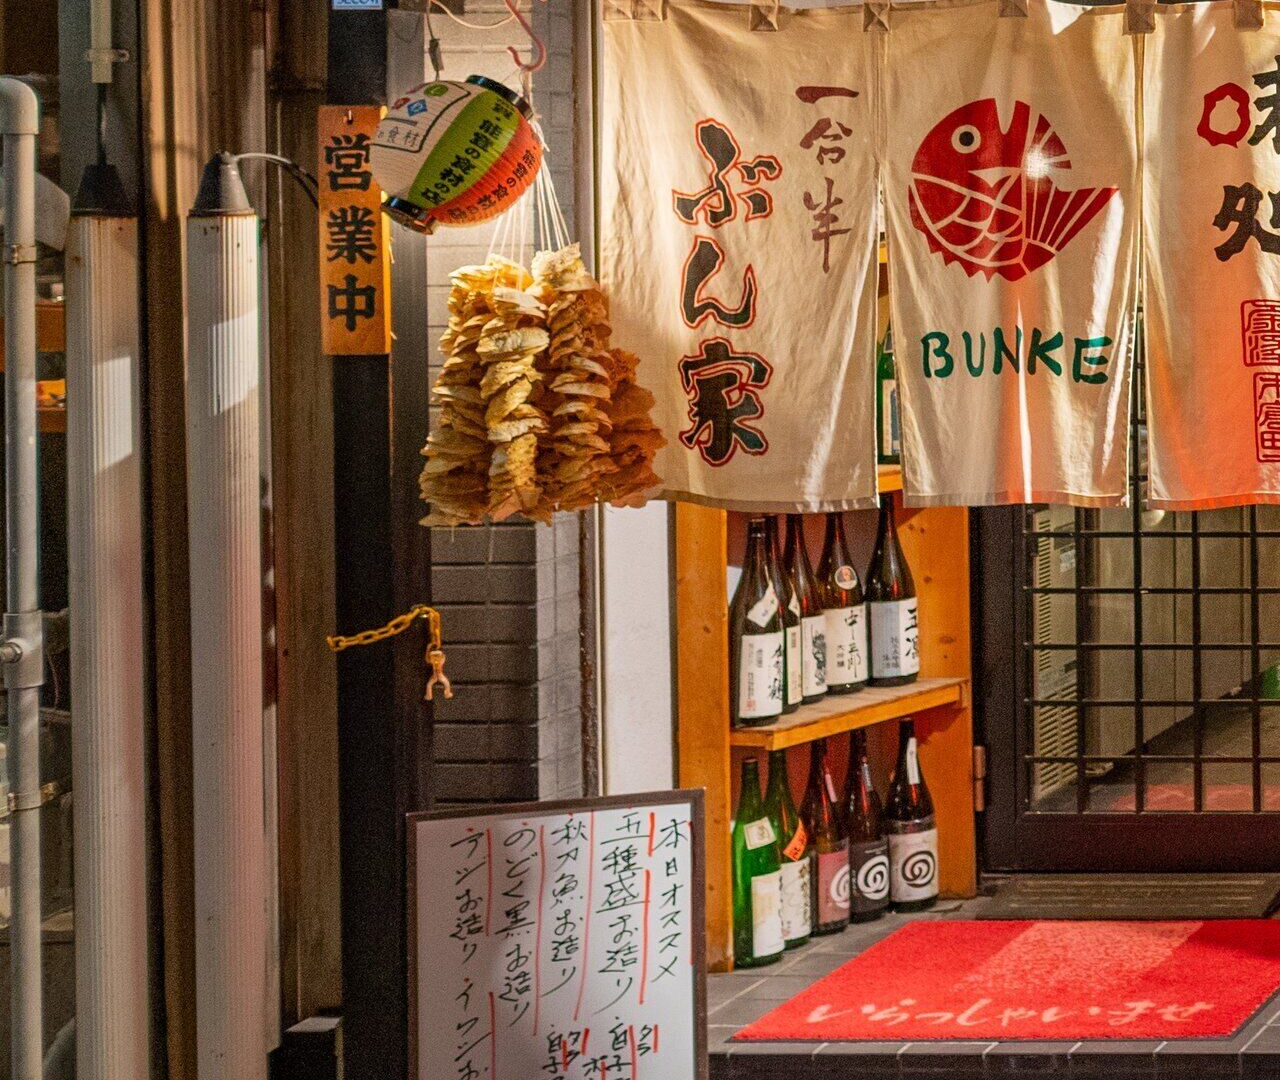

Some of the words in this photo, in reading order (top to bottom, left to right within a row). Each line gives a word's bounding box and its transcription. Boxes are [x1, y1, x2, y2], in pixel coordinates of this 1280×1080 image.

[324, 133, 378, 332] 営業中
[796, 85, 860, 273] 一合半
[672, 118, 782, 467] ぶん家
[920, 326, 1112, 385] BUNKE
[652, 817, 690, 983] 本日オススメ
[805, 996, 1215, 1028] いらっしゃいませ
